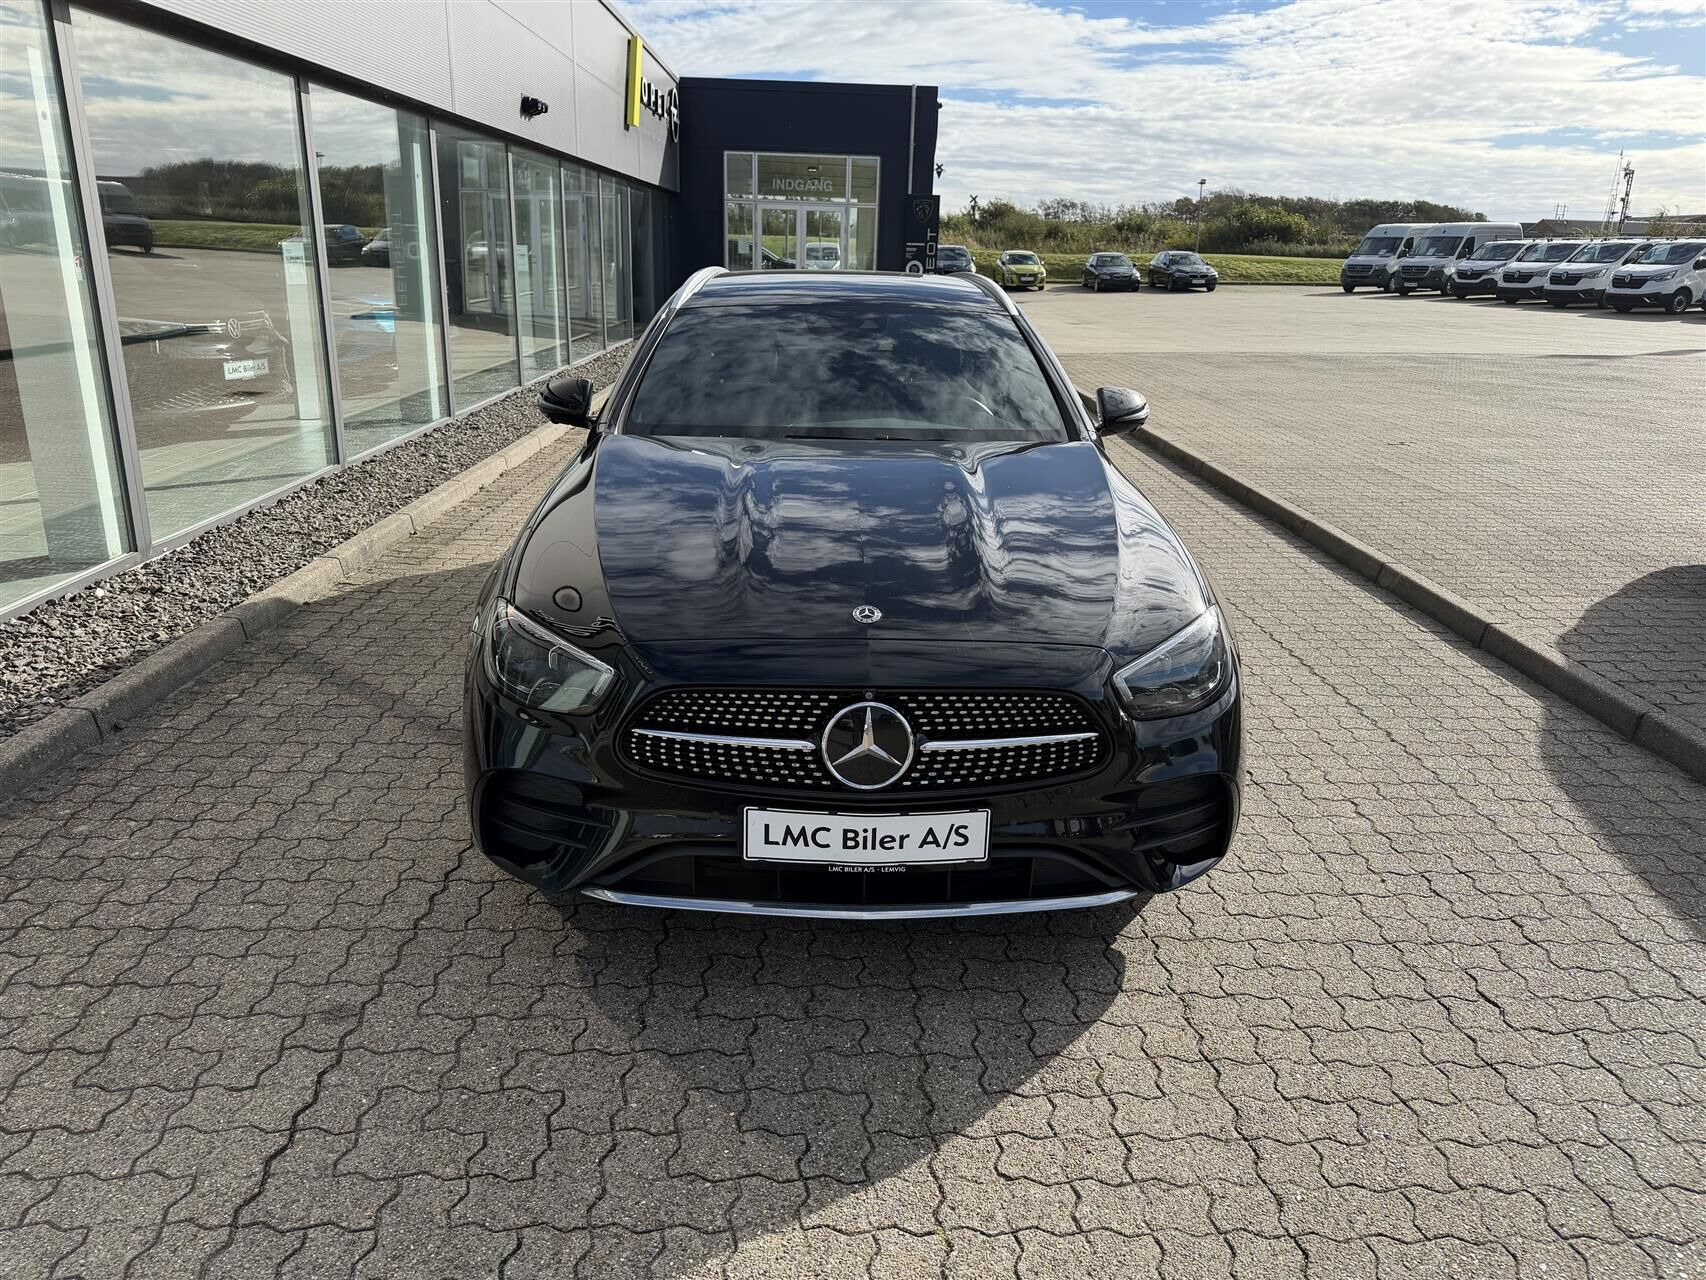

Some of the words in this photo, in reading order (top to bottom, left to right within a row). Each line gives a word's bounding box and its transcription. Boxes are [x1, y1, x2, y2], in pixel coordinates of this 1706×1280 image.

[772, 178, 833, 192] INDGANG
[925, 228, 937, 274] EOT
[228, 366, 242, 375] LMC
[243, 364, 256, 373] Biler
[763, 823, 832, 848] LMC
[841, 827, 911, 851] Biler
[917, 823, 970, 850] A/S
